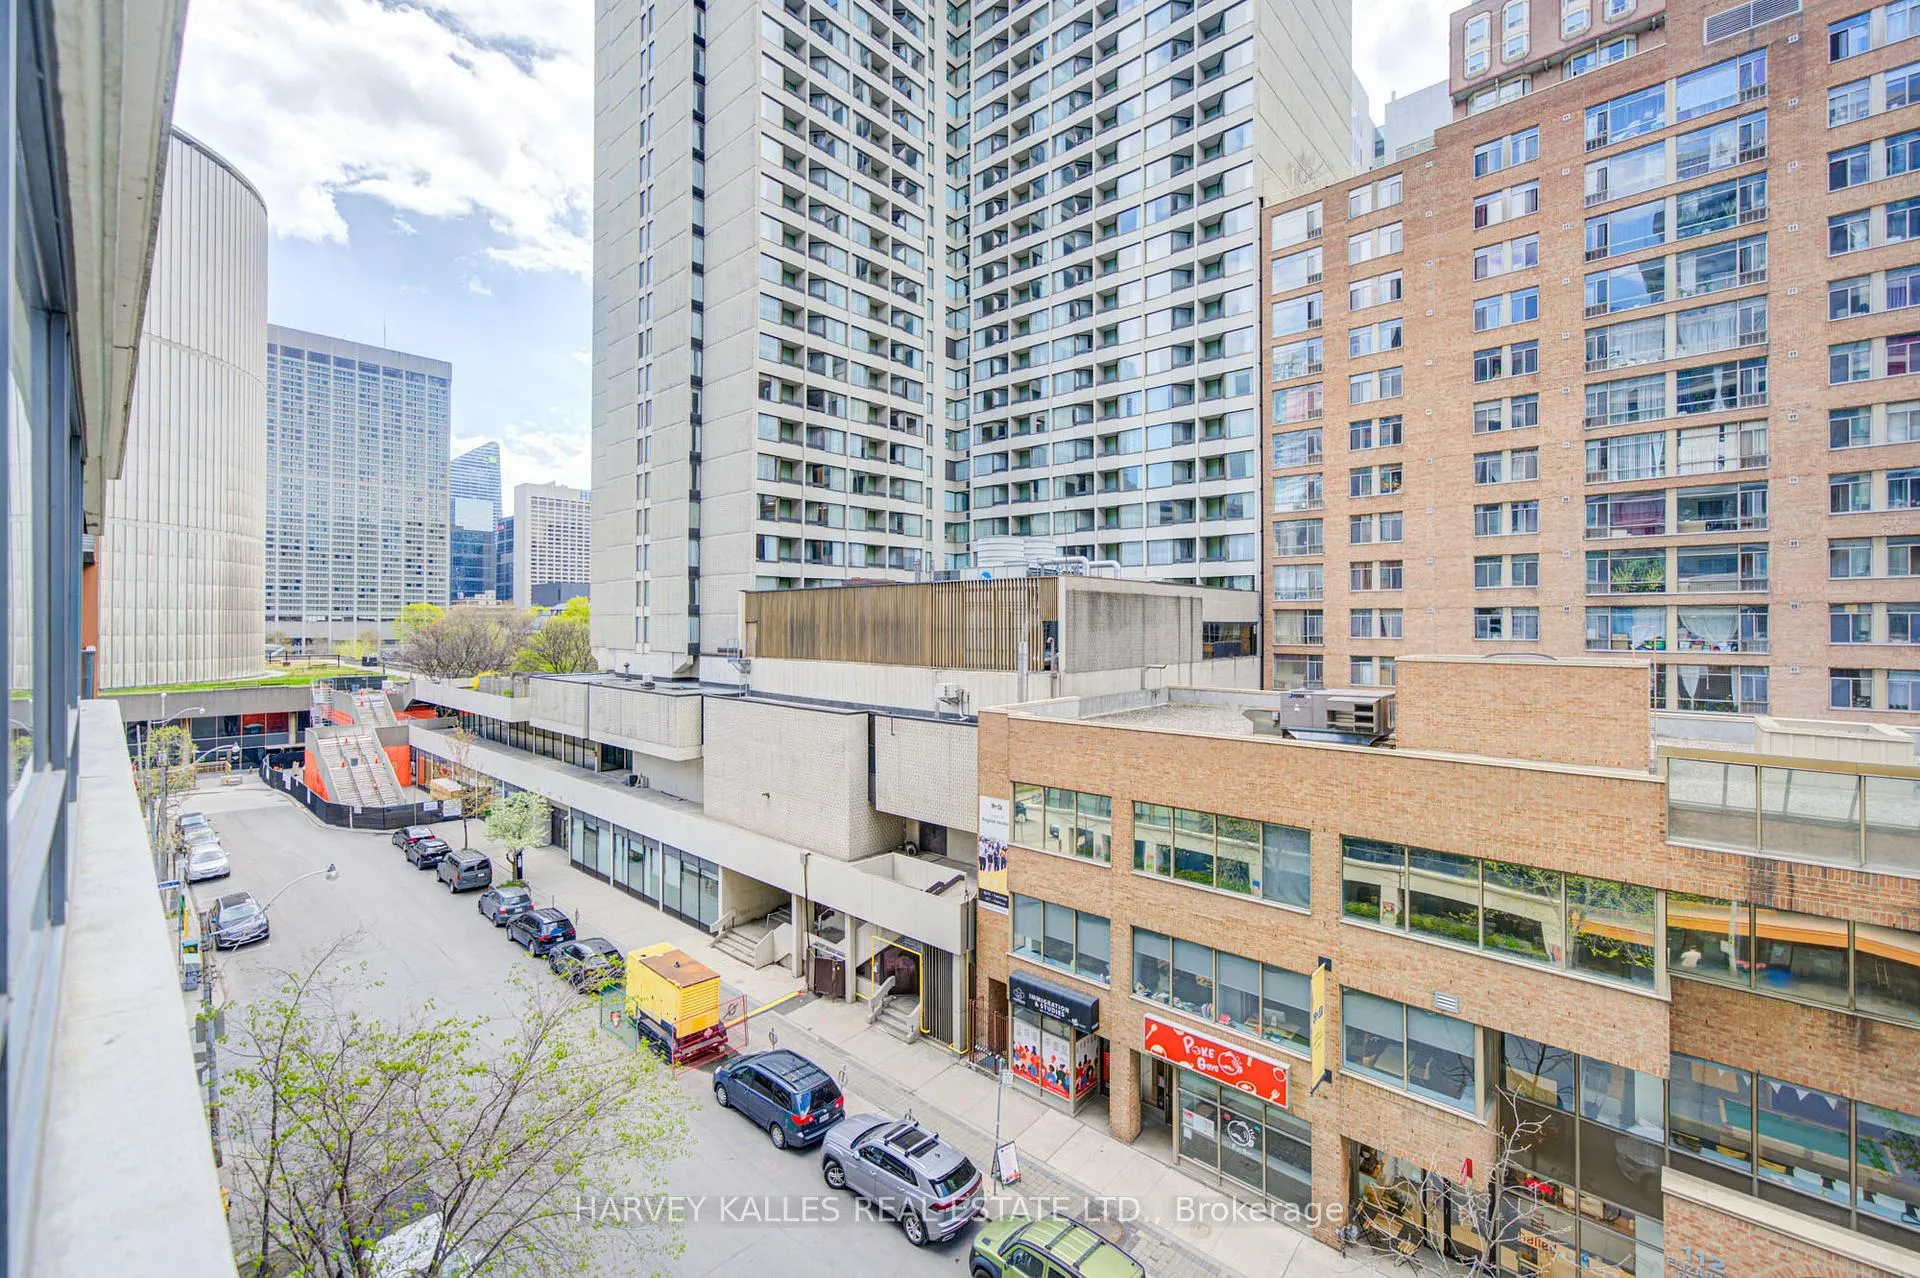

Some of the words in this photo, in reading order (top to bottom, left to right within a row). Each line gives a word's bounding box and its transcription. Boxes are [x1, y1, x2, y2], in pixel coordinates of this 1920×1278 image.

[1028, 992, 1070, 1014] IMMIGRATION
[1040, 1003, 1066, 1018] STUDIES
[1681, 1247, 1725, 1272] 112
